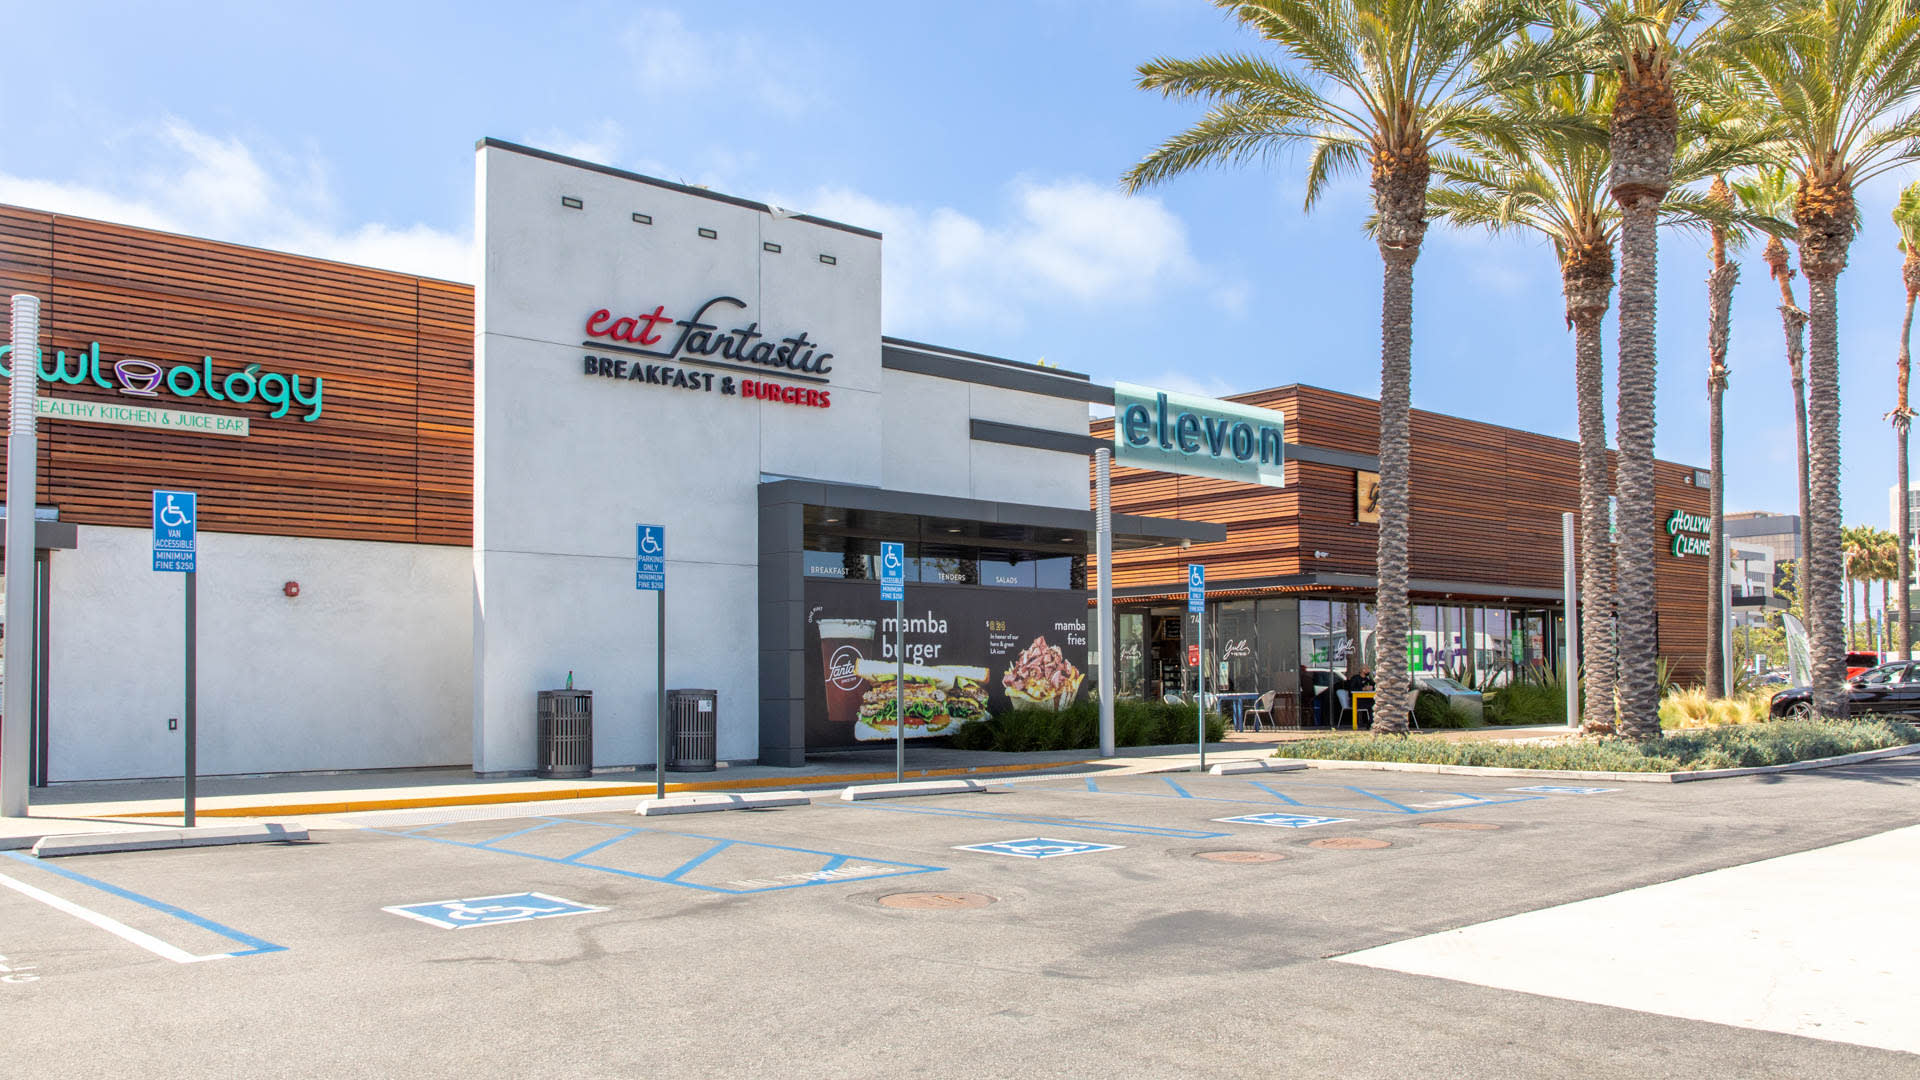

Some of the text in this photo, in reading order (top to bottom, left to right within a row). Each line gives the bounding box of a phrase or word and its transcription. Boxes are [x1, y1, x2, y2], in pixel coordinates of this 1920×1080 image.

[585, 296, 834, 374] eat fantastic
[584, 355, 831, 408] BREAKFAST & BURGERS
[100, 406, 157, 423] KITCHEN
[161, 411, 169, 424] &
[176, 414, 212, 428] JUICE
[216, 417, 244, 431] BAR
[1122, 391, 1283, 466] elevon
[1668, 510, 1711, 534] HOLLYW
[167, 529, 181, 538] VAN
[155, 538, 193, 549] ACCESSIBLE
[1674, 534, 1710, 557] CLEANE
[156, 551, 193, 560] MINIMUM
[155, 560, 194, 570] FINE $250
[643, 563, 659, 571] ONLY
[810, 565, 849, 576] BREAKFAST
[938, 573, 966, 582] TENDERS
[995, 576, 1018, 585] SALADS
[882, 610, 948, 633] mamba
[1054, 619, 1086, 631] mamba
[1067, 633, 1086, 645] fries
